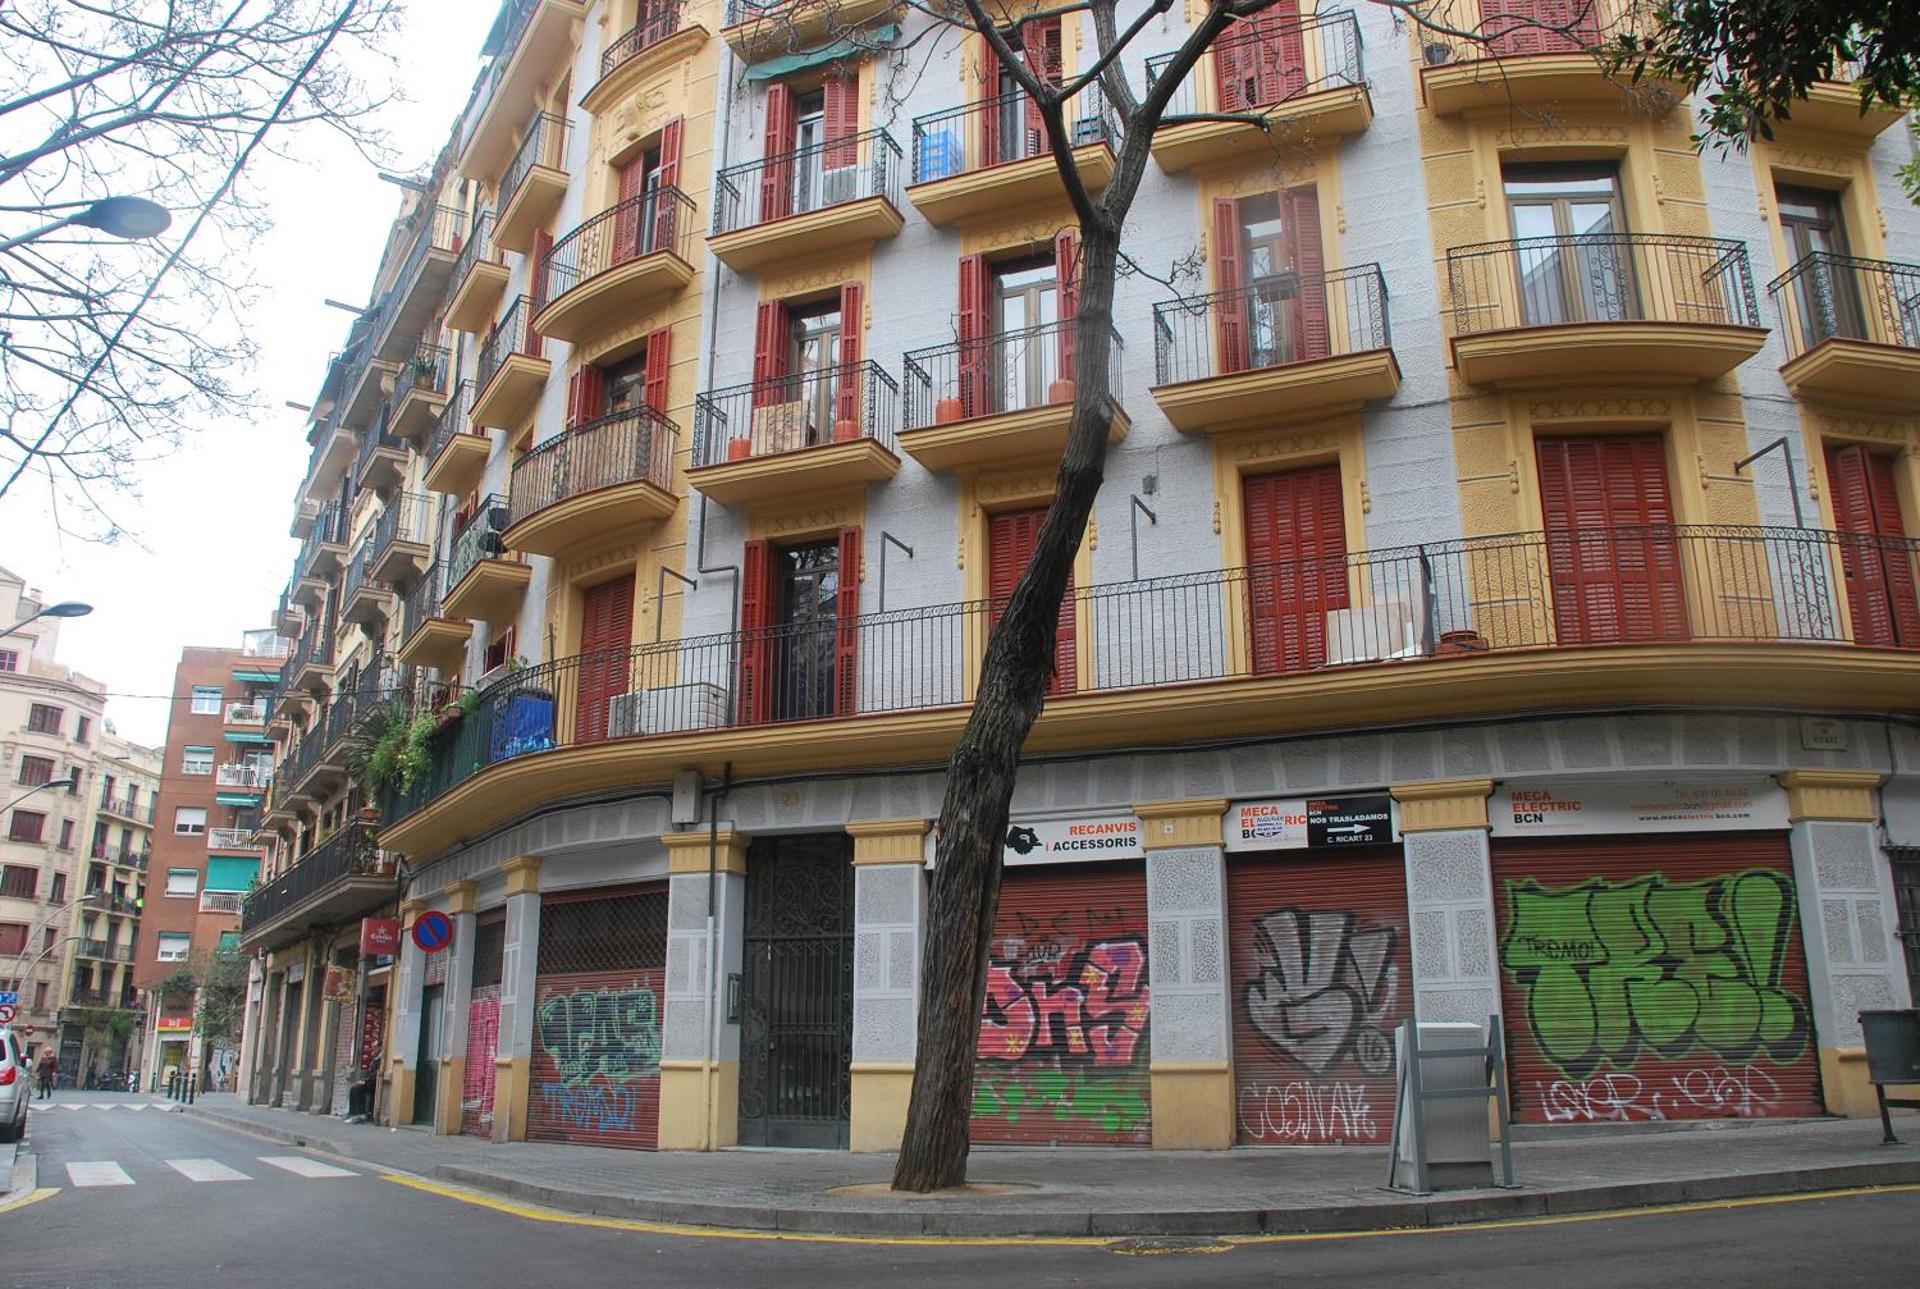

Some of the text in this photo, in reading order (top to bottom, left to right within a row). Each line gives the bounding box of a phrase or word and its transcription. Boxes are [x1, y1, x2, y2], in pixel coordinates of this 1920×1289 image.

[1511, 790, 1552, 801] MECA
[1240, 805, 1278, 817] MECA
[1512, 800, 1582, 812] ELECTRIC
[1241, 814, 1307, 828] ELRIC
[1310, 812, 1389, 825] NOS TRASLADAMOS
[1513, 813, 1543, 824] BCN
[1069, 821, 1137, 836] RECANVIS
[1053, 836, 1137, 852] ACCESSORIS
[1336, 834, 1363, 843] RICART
